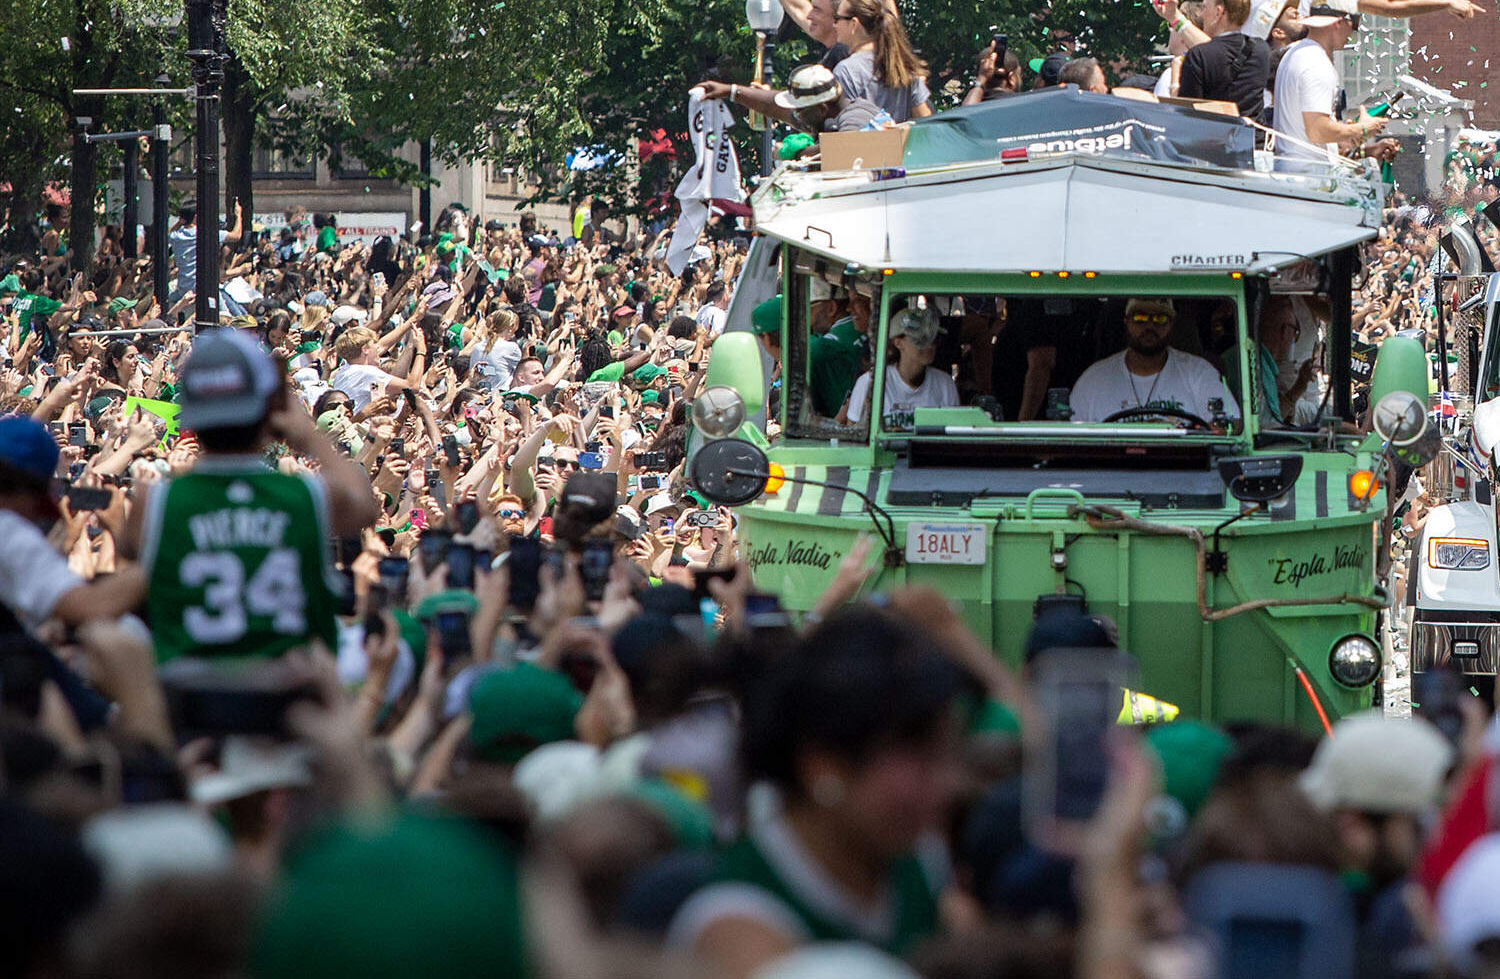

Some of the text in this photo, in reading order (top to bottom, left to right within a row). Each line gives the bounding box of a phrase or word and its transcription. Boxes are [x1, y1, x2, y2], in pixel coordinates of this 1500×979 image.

[1171, 255, 1245, 265] CHARTER
[916, 534, 972, 554] 18ALY
[179, 547, 308, 645] 34
